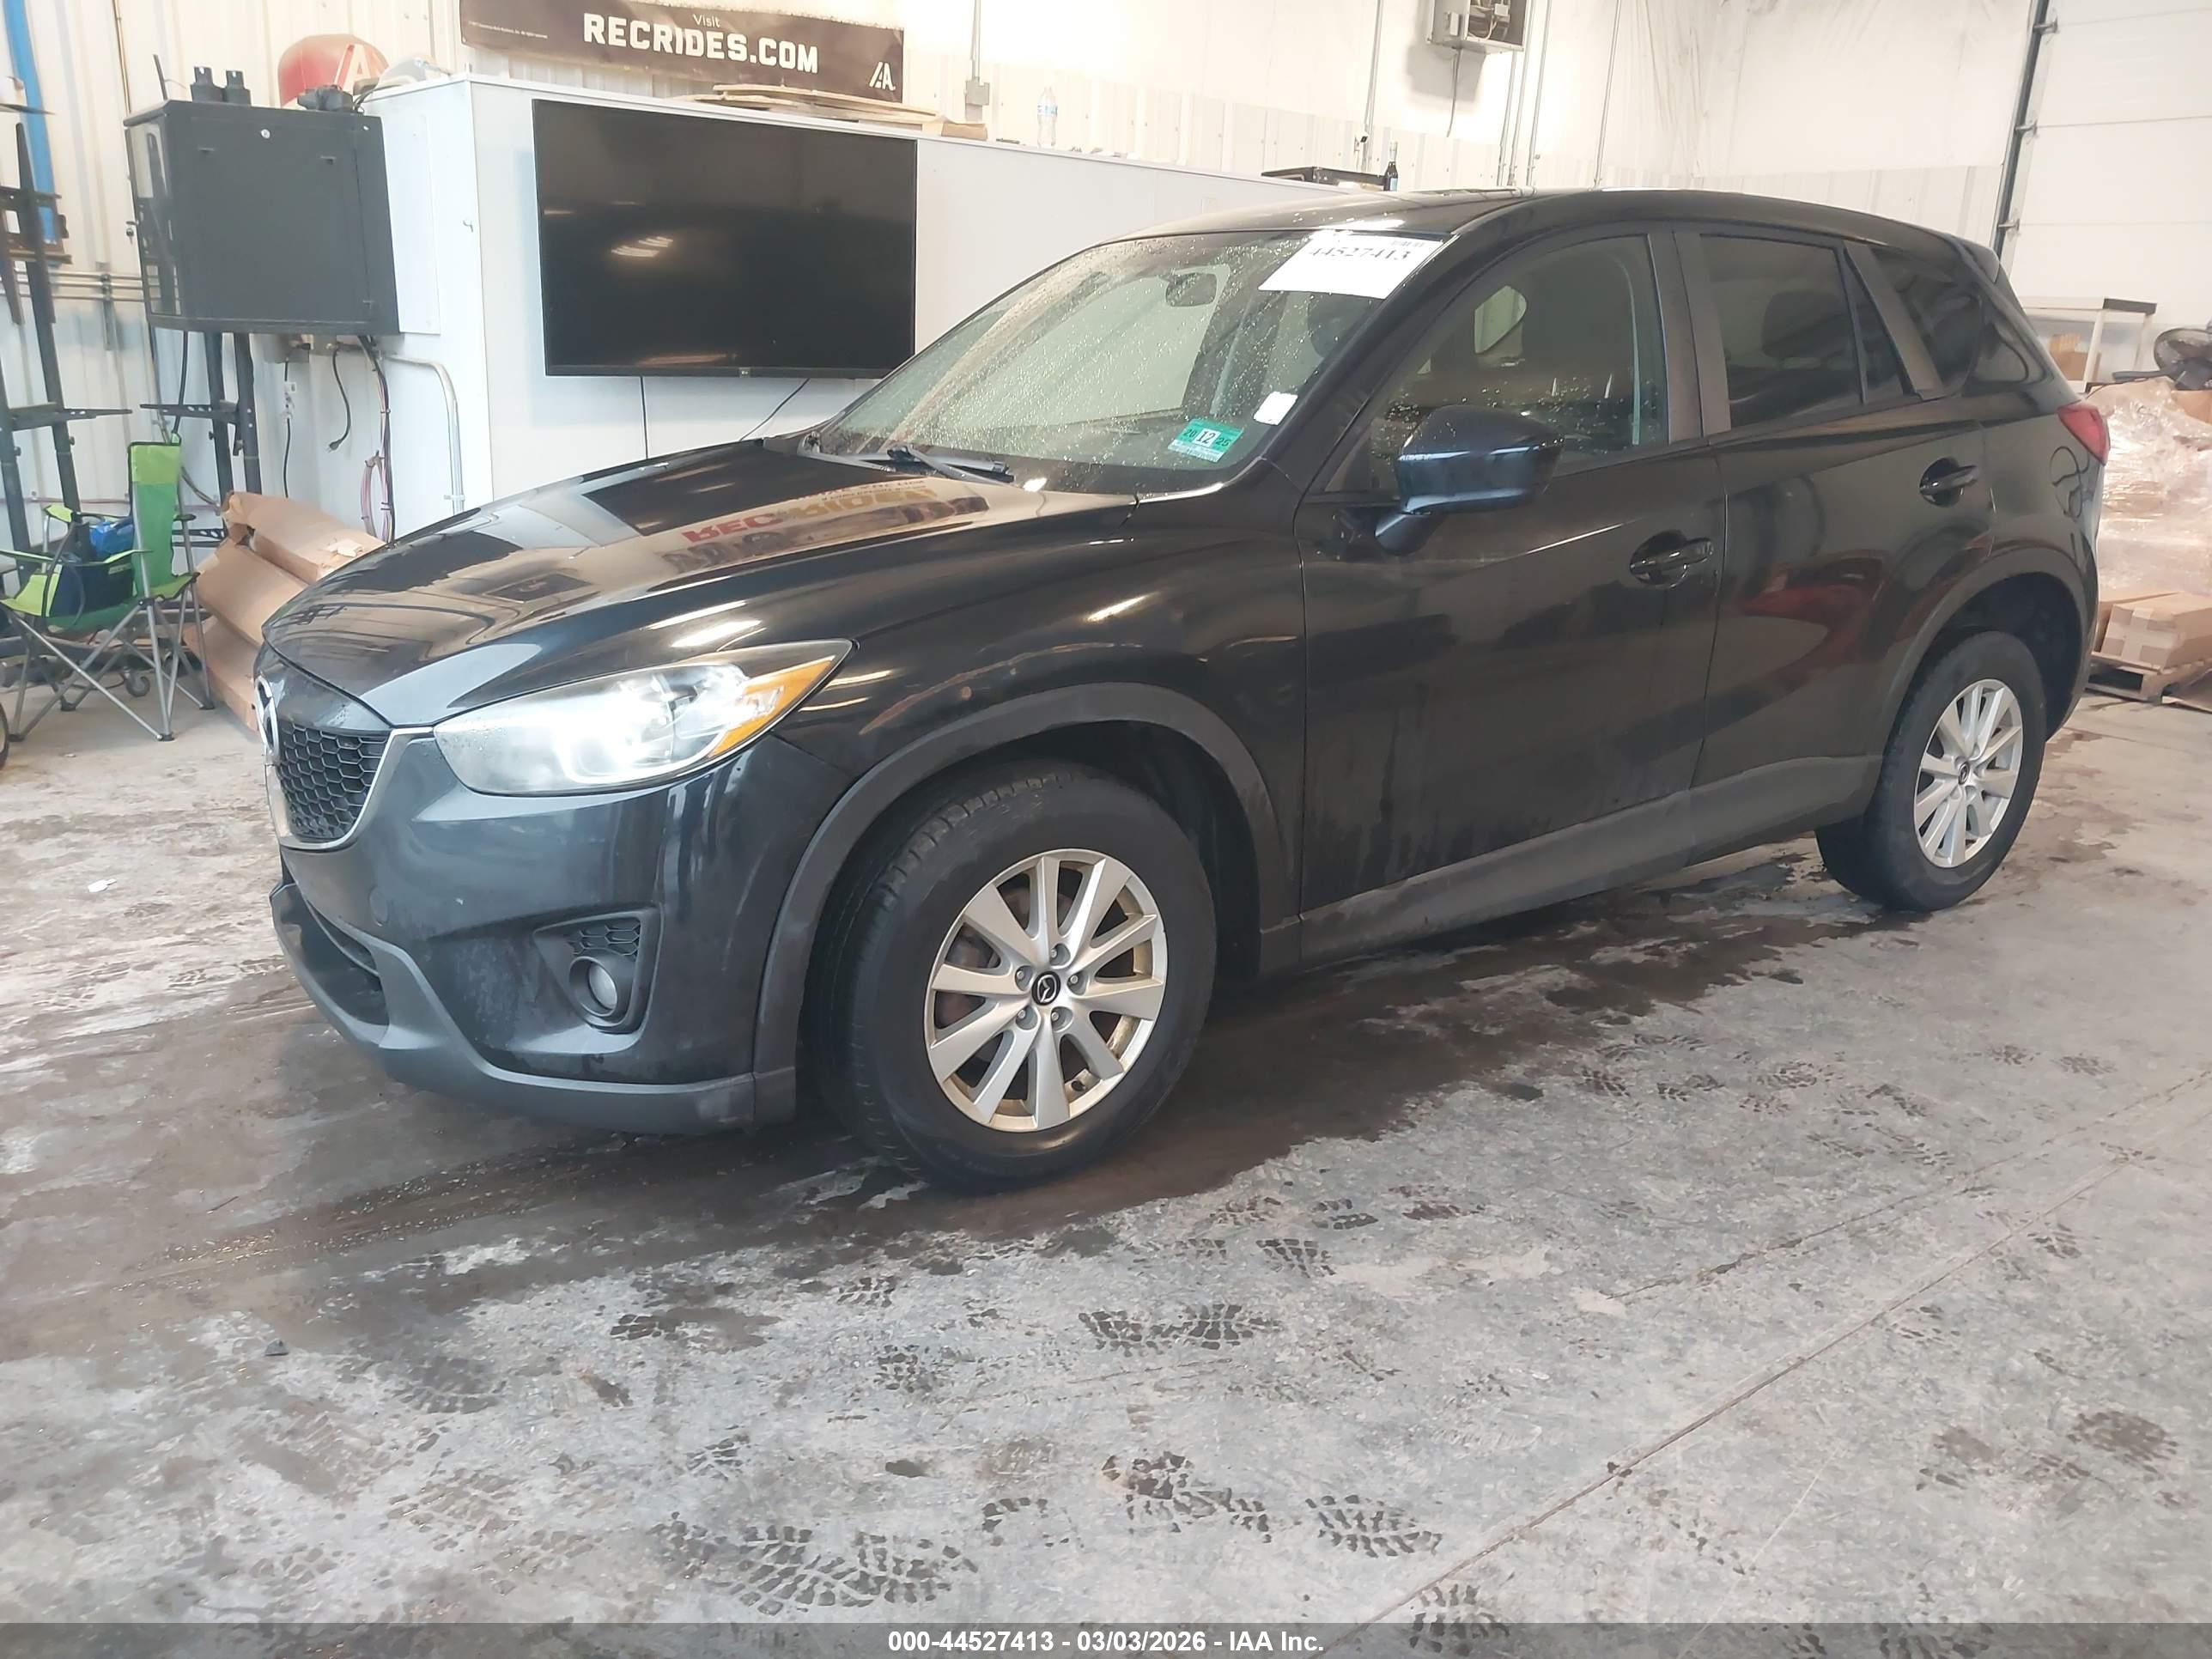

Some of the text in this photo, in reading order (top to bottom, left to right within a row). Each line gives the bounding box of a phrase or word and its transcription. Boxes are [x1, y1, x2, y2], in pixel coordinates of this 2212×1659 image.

[693, 14, 720, 28] Visit
[584, 13, 818, 74] RECRIDES.COM
[1196, 430, 1216, 444] 12
